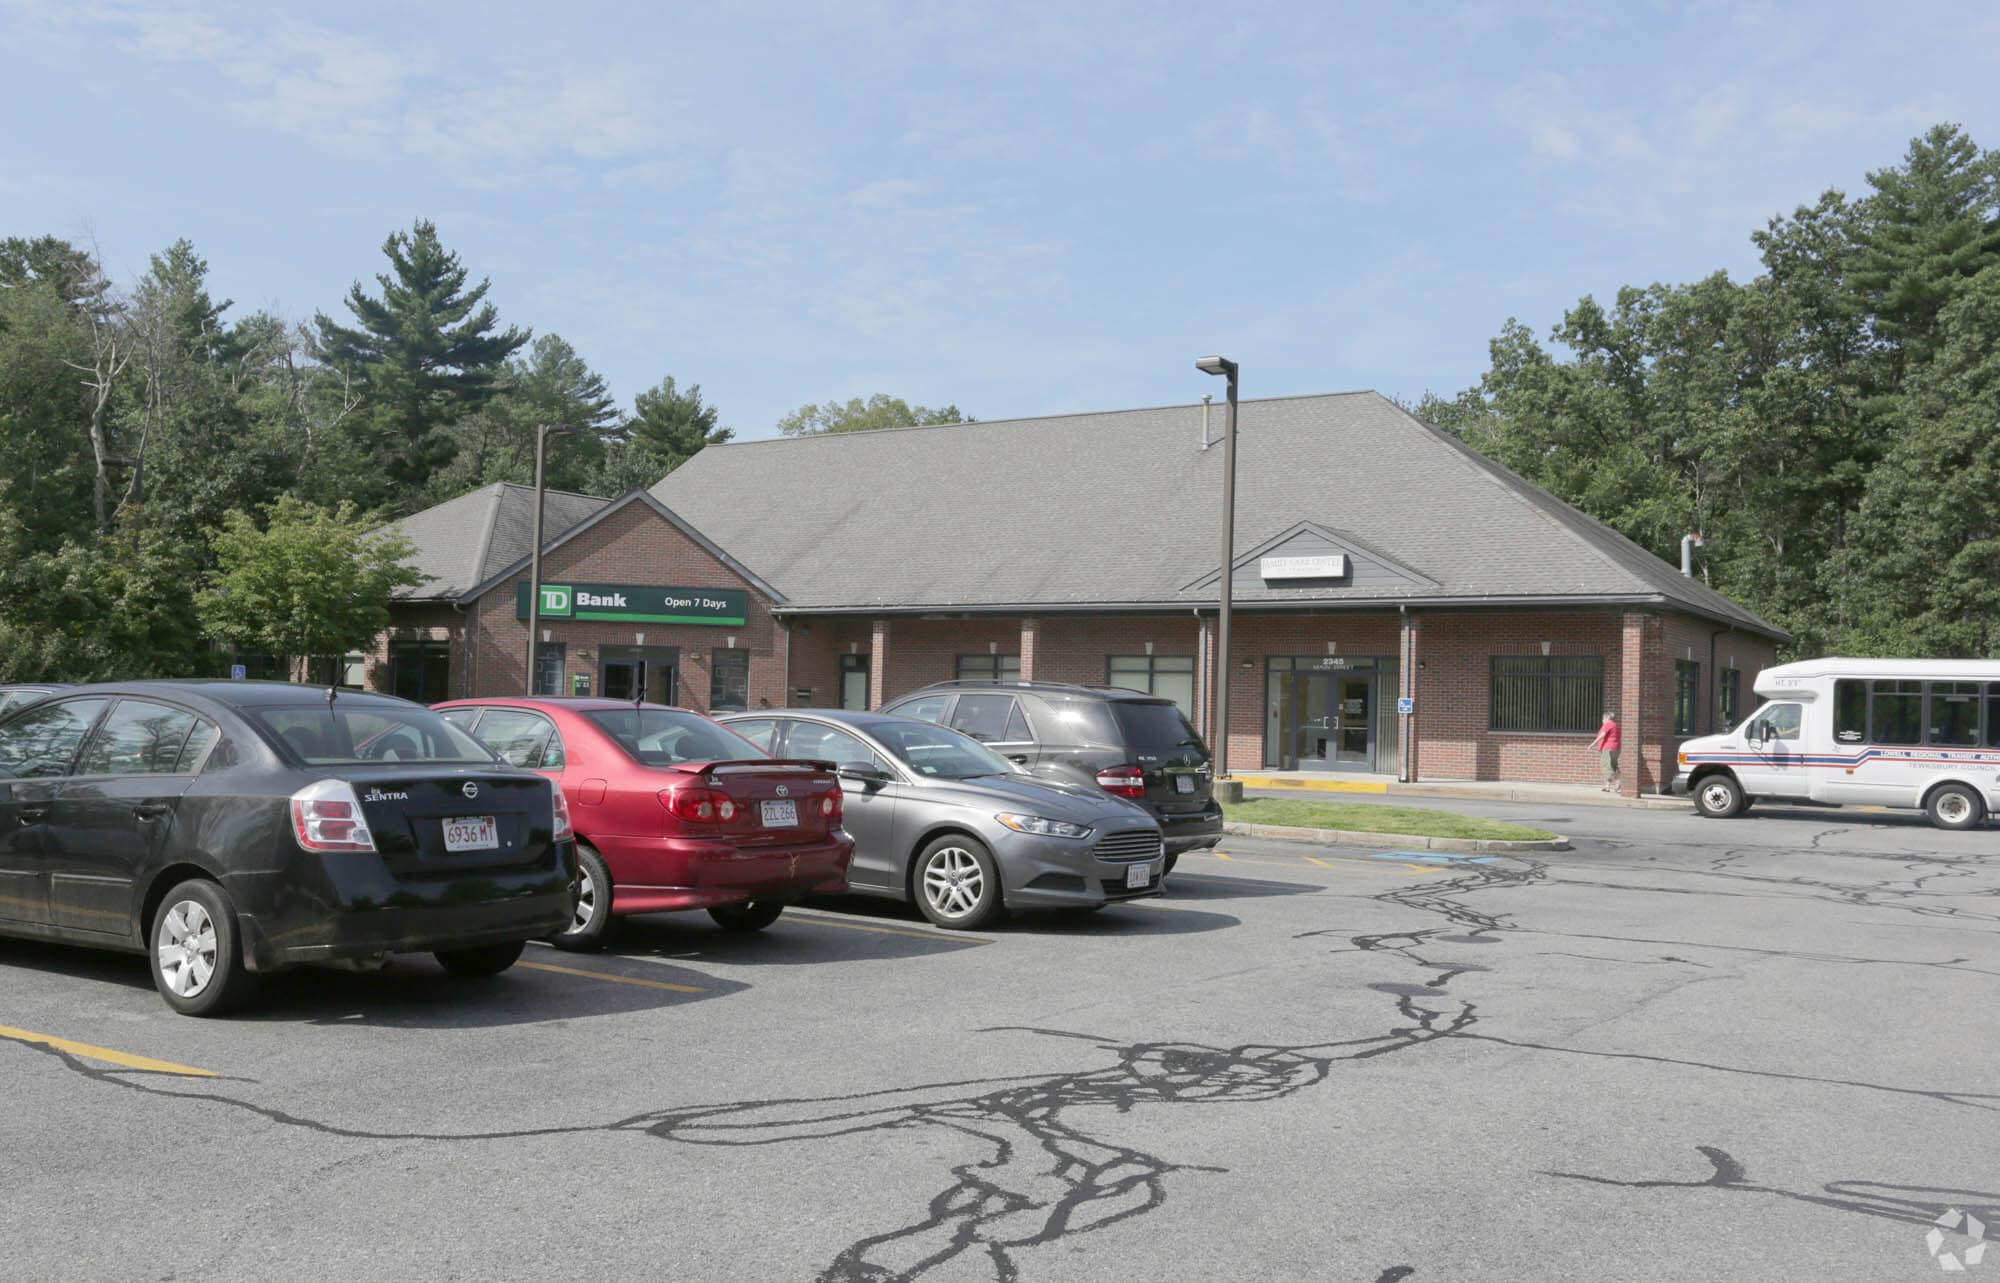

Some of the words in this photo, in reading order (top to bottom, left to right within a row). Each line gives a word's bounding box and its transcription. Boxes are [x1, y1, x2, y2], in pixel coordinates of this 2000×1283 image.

[540, 591, 568, 609] TD
[577, 592, 627, 608] Bank
[664, 597, 691, 609] Open
[693, 598, 700, 607] 7
[703, 598, 727, 609] Days
[1322, 657, 1345, 666] 2345
[1909, 762, 1958, 770] TEWKSBURY
[364, 792, 409, 802] SENTRA
[448, 825, 478, 843] 6936
